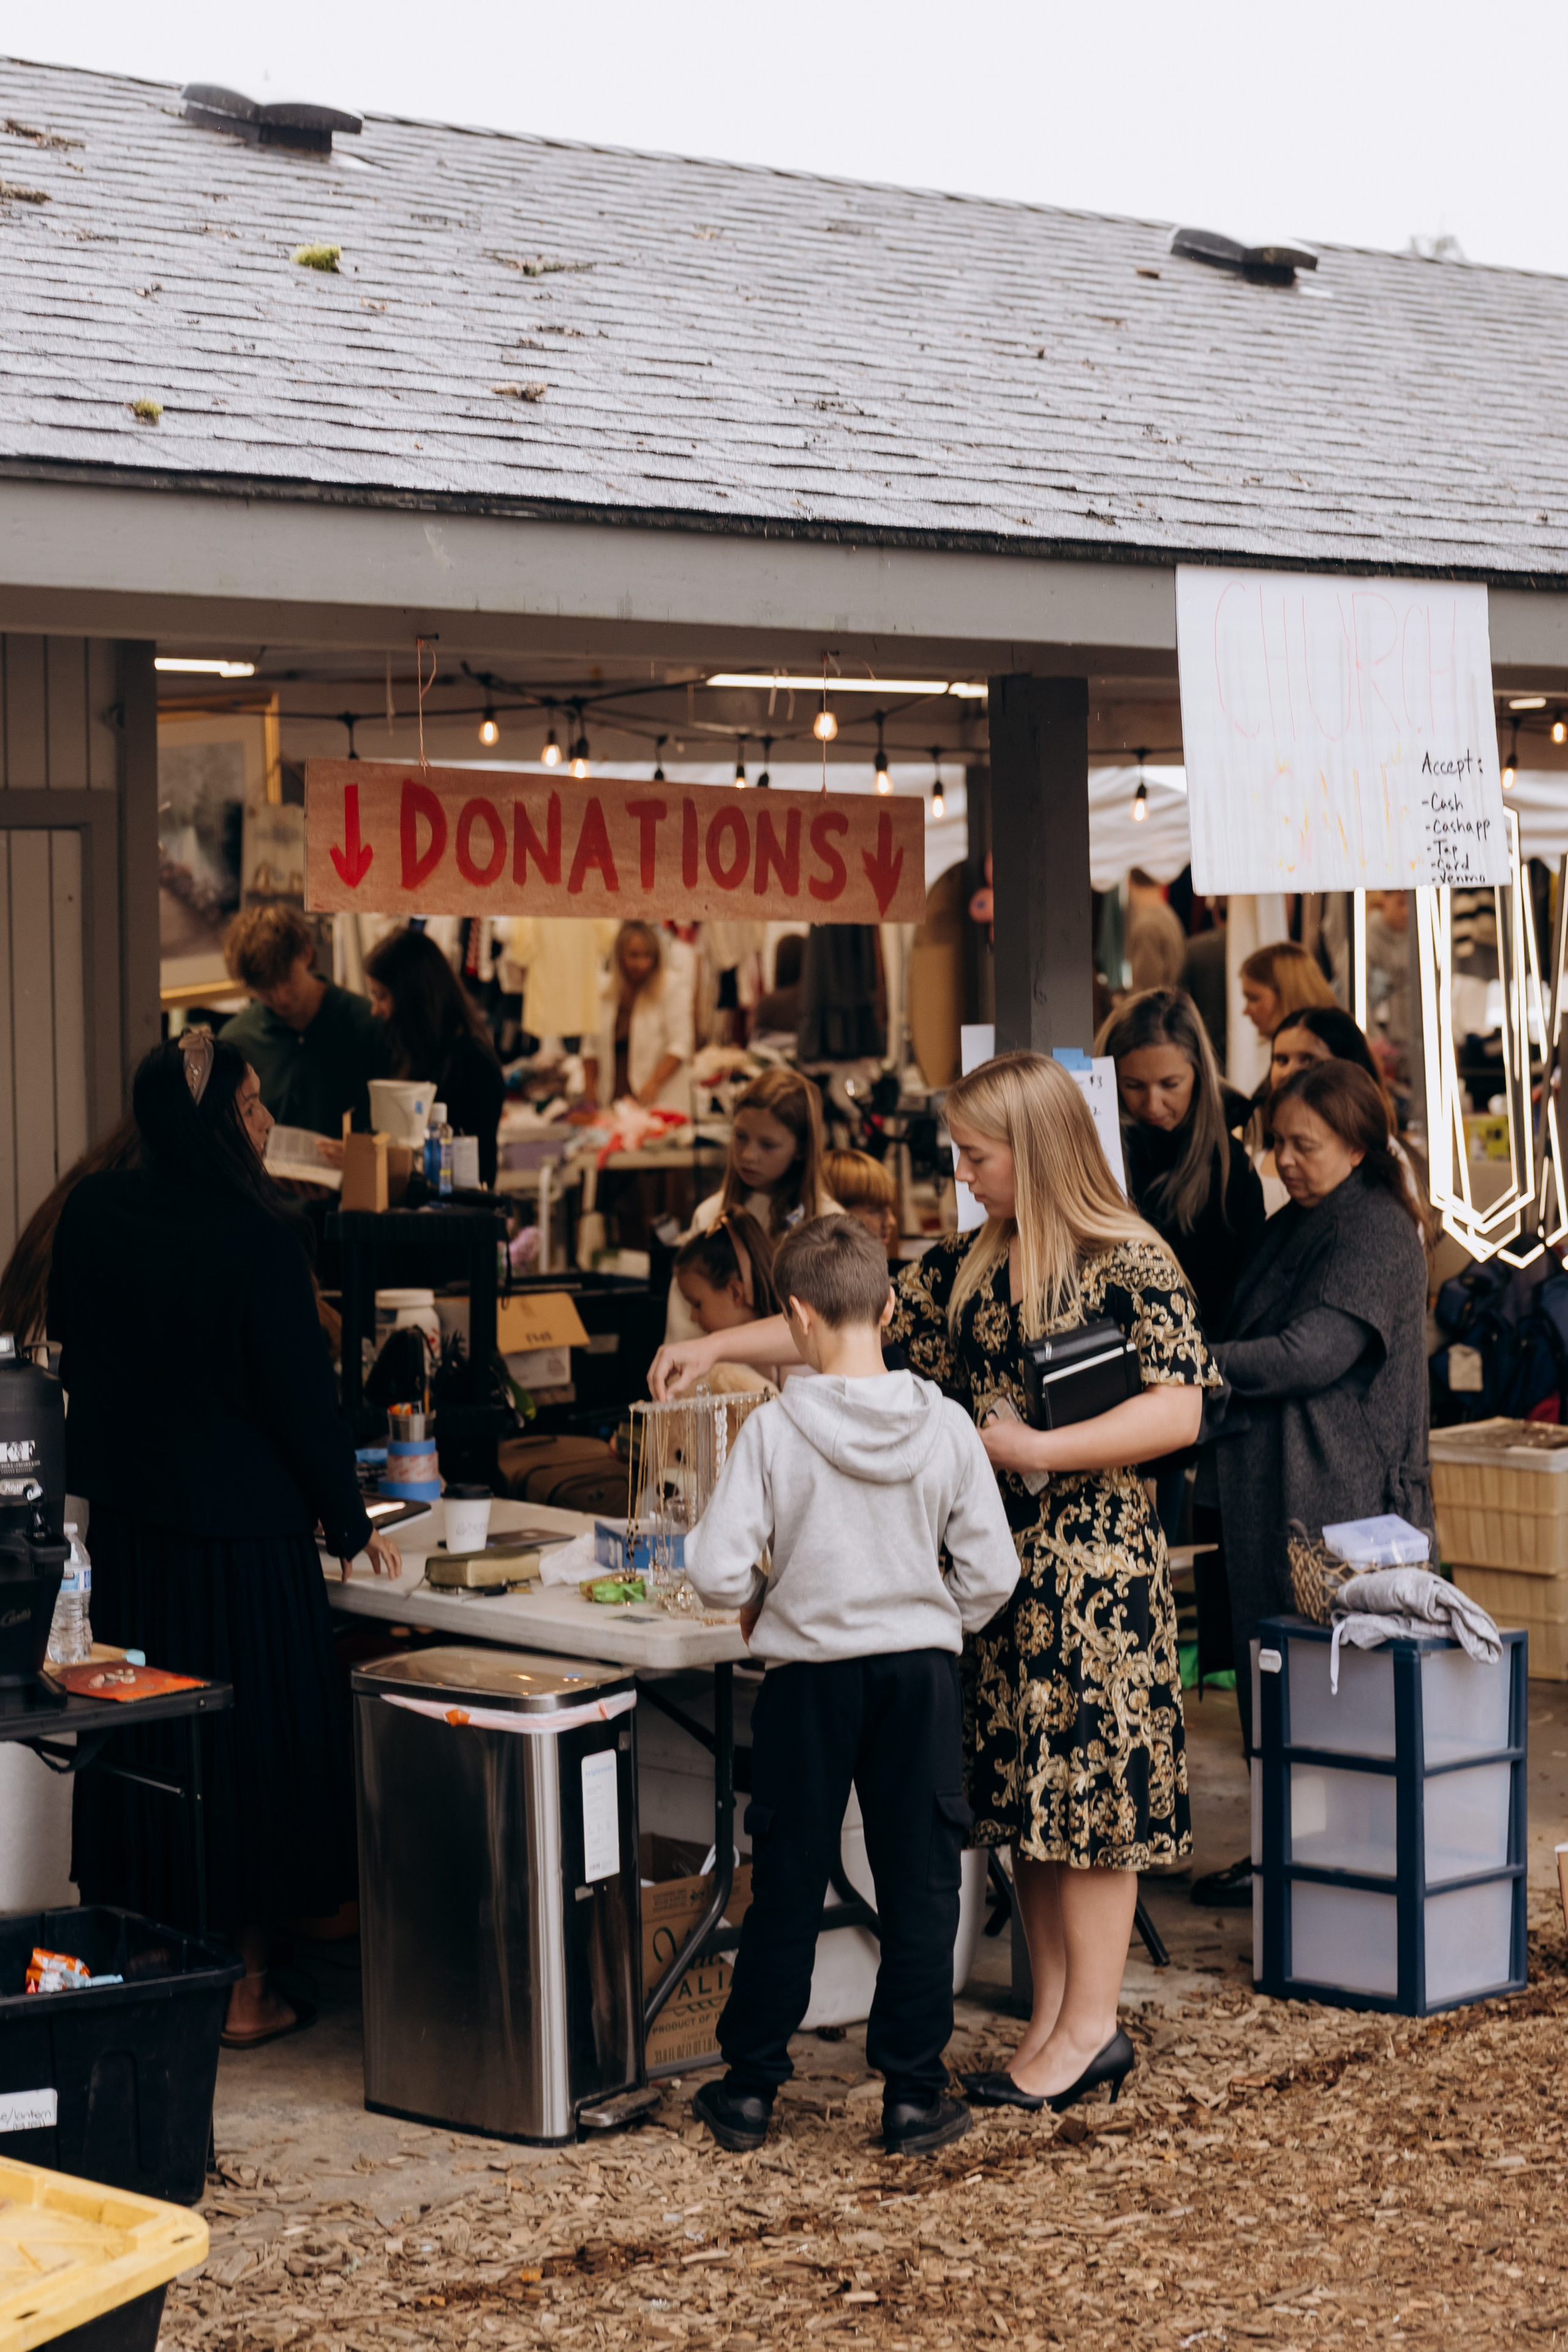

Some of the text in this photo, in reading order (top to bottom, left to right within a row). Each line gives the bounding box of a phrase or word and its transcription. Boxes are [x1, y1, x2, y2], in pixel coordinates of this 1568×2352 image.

[1213, 580, 1458, 742] CHURCH
[1422, 747, 1483, 782] Accept:
[399, 778, 849, 902] DONATIONS
[652, 2017, 696, 2035] PRODUCT
[699, 2014, 710, 2024] OF
